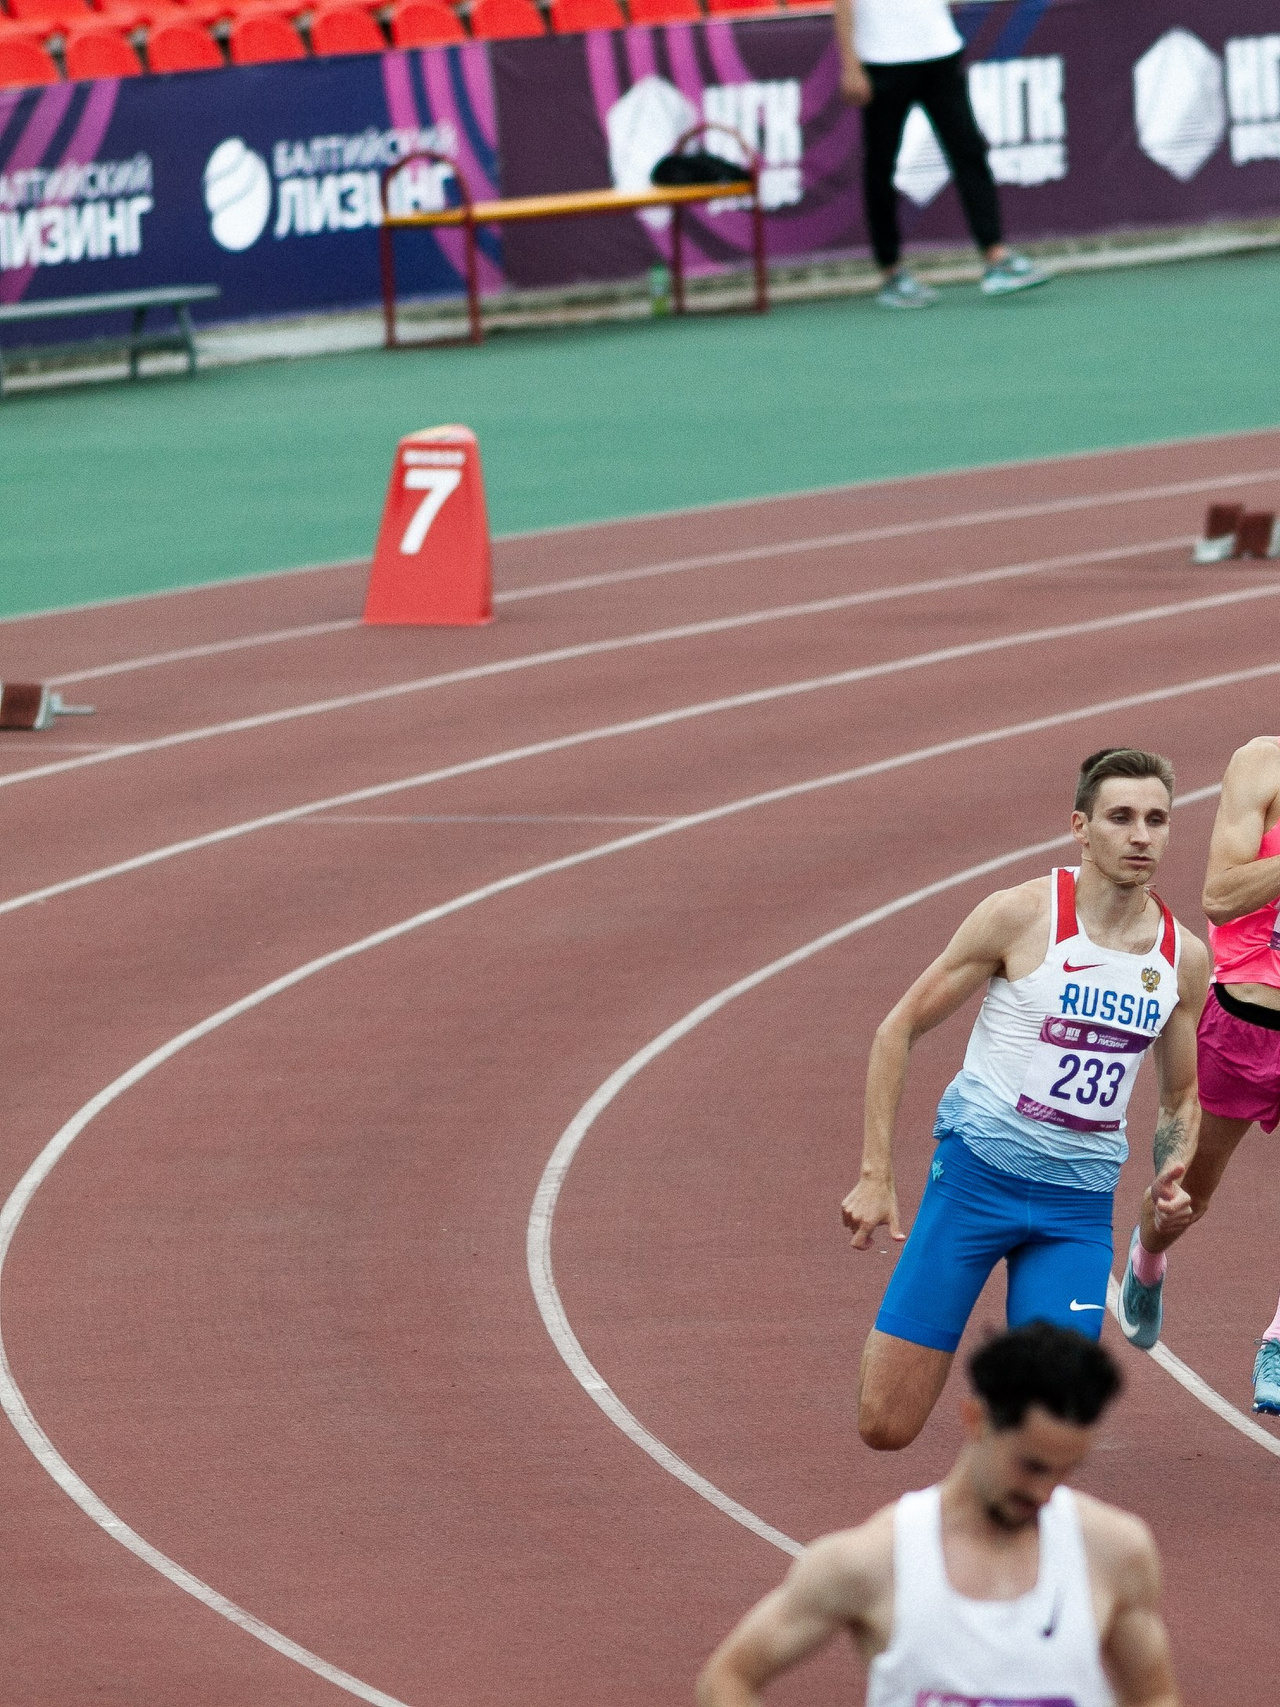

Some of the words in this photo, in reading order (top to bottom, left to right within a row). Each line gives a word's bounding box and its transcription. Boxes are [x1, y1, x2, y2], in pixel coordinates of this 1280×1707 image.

[400, 468, 463, 555] 7
[1059, 982, 1161, 1031] RUSSIA
[1049, 1053, 1126, 1108] 233
